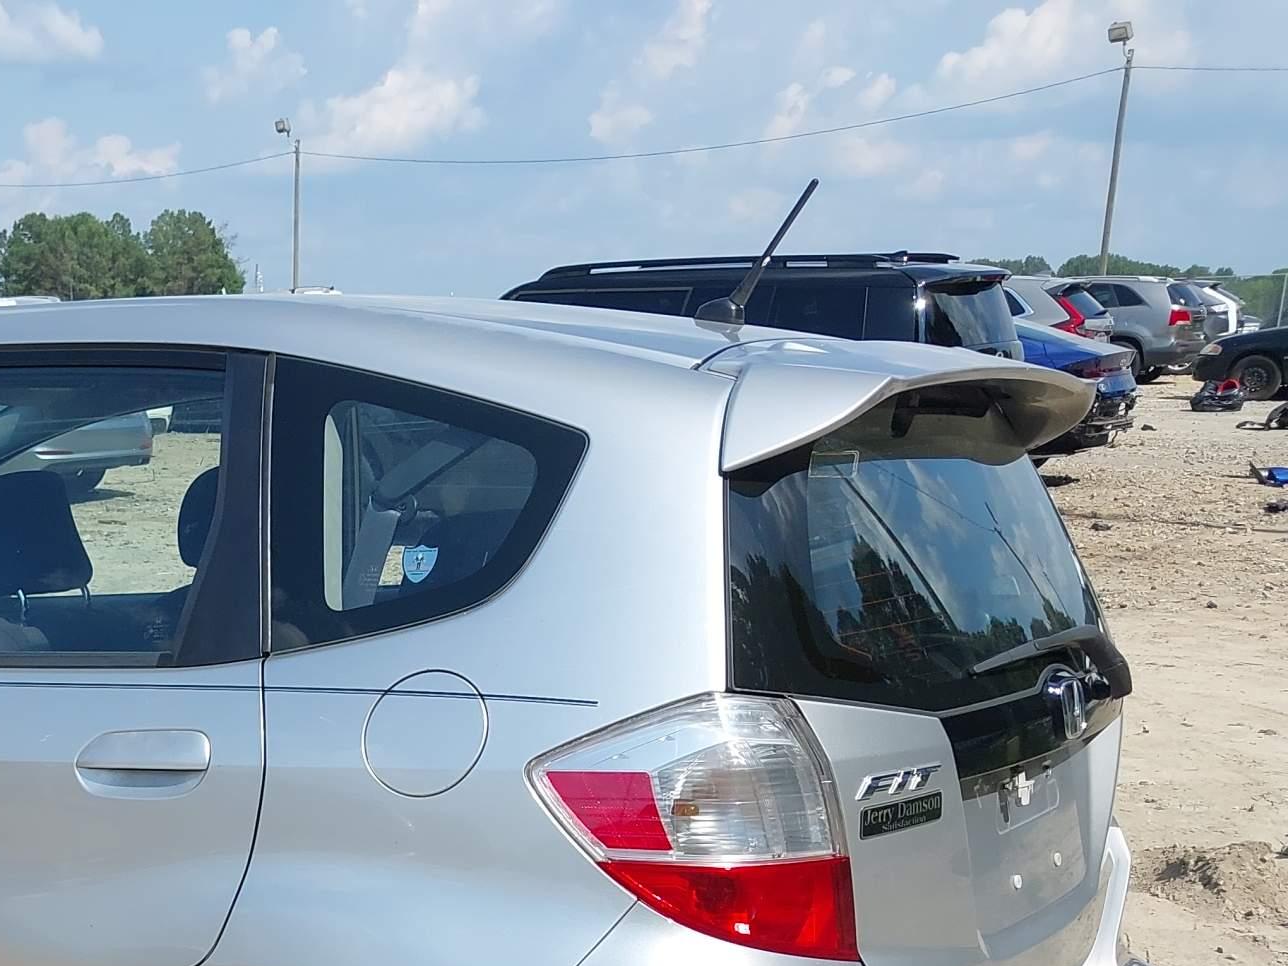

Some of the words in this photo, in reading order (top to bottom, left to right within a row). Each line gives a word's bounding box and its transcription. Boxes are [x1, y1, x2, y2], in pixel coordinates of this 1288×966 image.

[854, 761, 942, 801] FIT
[864, 806, 895, 826] Jerry
[897, 796, 941, 819] Damson
[881, 815, 927, 833] Satisfaction
